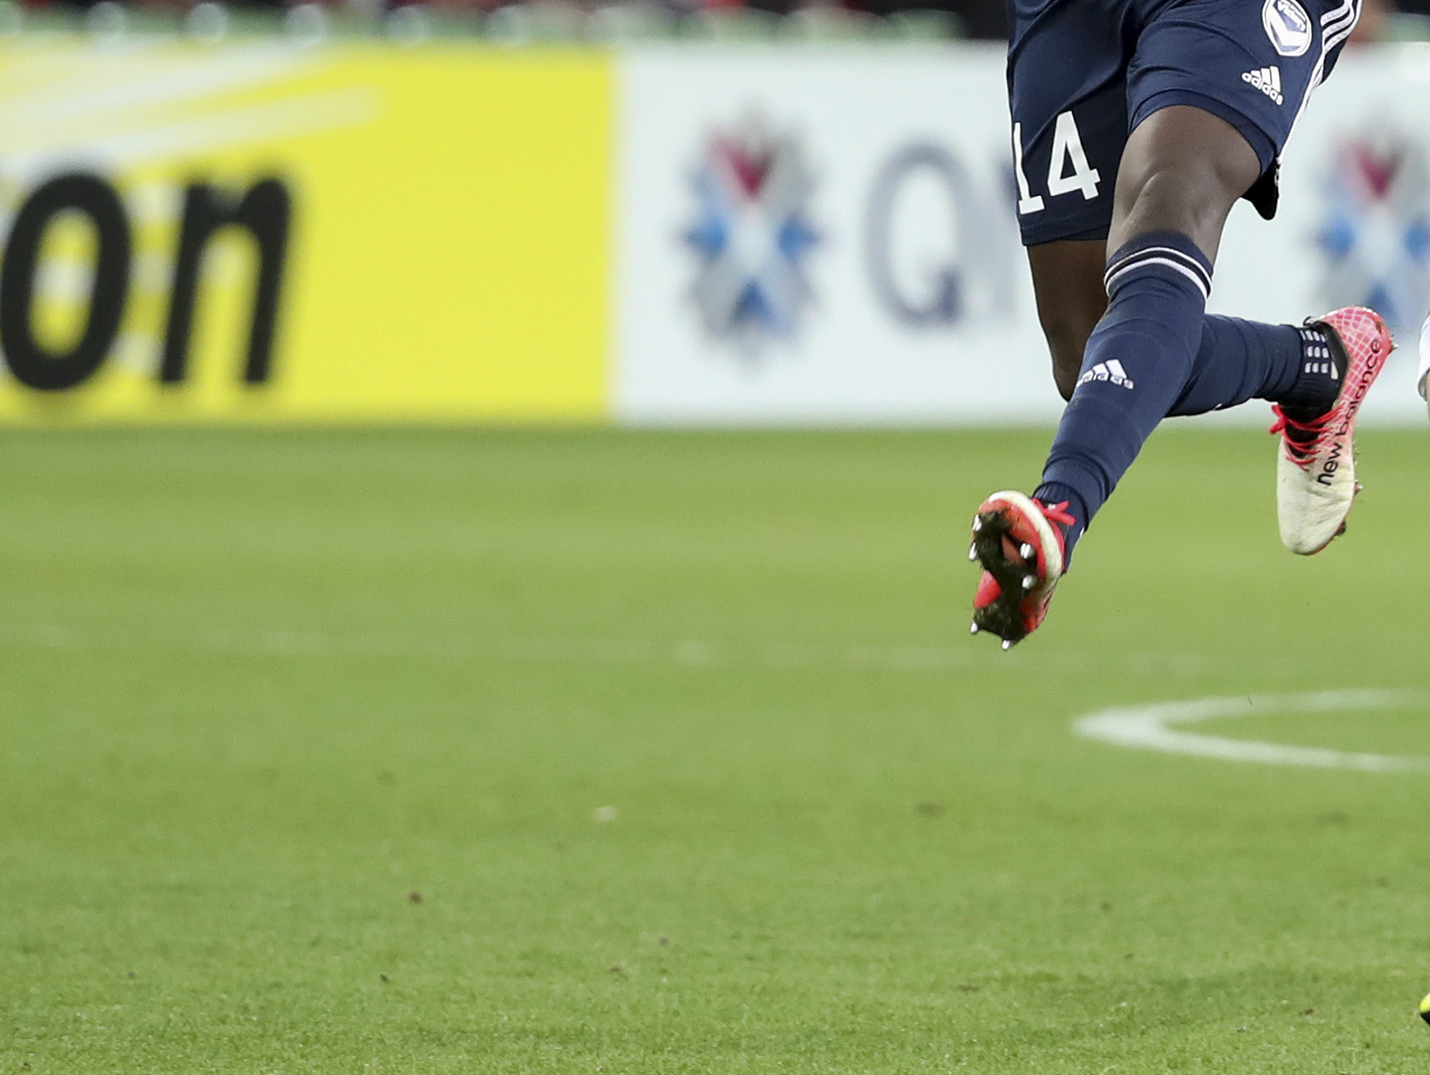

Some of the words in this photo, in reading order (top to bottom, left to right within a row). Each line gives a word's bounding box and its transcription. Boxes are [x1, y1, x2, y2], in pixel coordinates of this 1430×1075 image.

[1241, 71, 1284, 105] adidas
[1012, 110, 1101, 215] 14
[0, 173, 291, 391] on
[1316, 442, 1343, 486] new
[1335, 338, 1381, 436] balance
